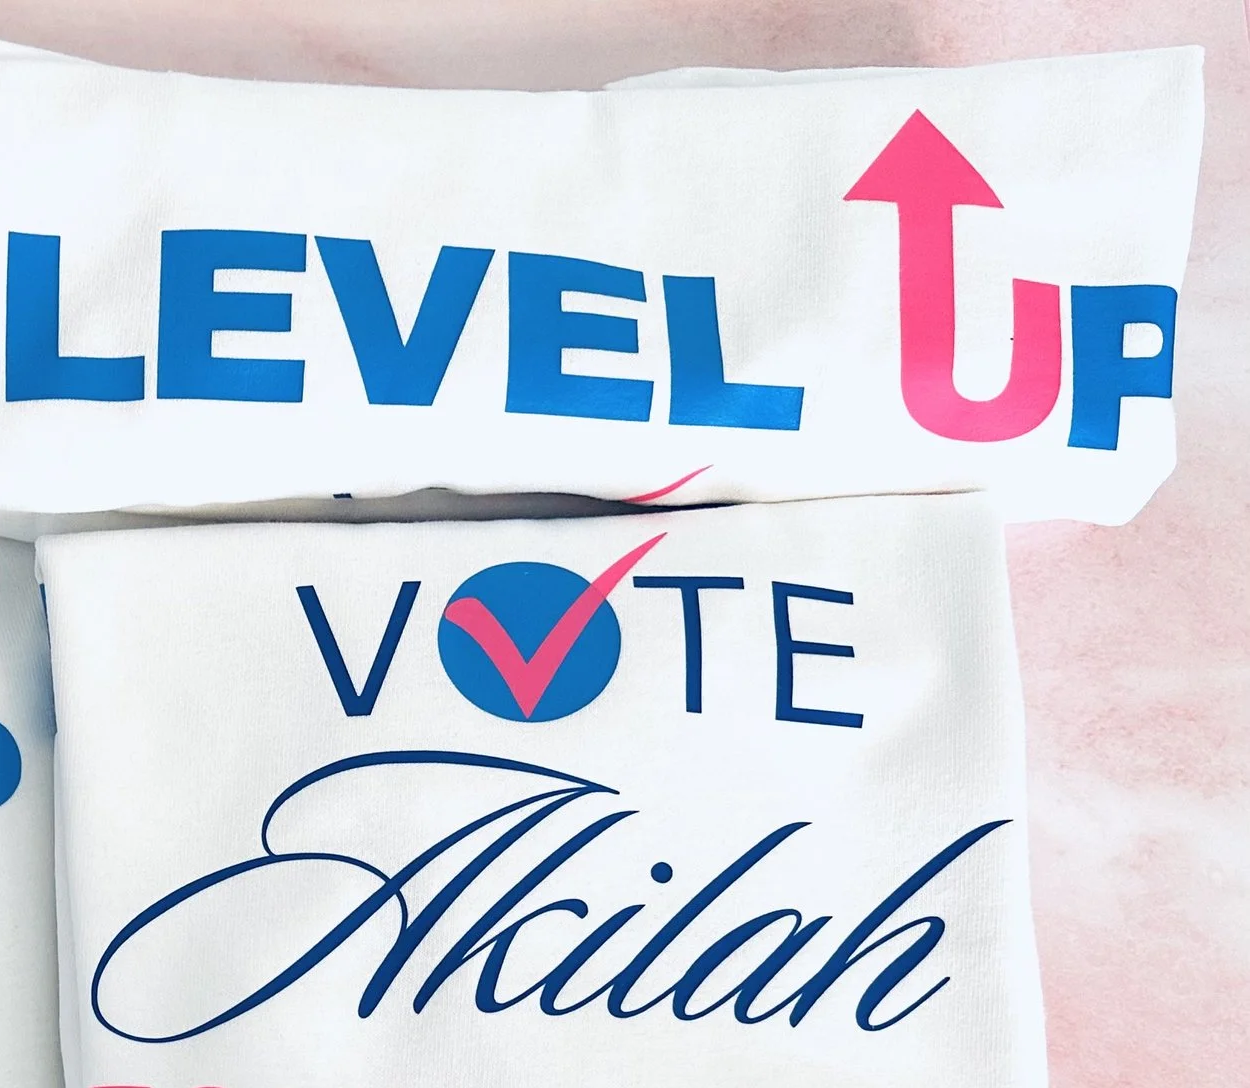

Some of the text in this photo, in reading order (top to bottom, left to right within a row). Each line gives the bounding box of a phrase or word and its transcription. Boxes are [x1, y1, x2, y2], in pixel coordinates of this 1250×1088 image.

[6, 109, 1178, 451] LEVEL UP
[295, 533, 864, 729] VOTE
[91, 750, 1013, 1045] Akilah
